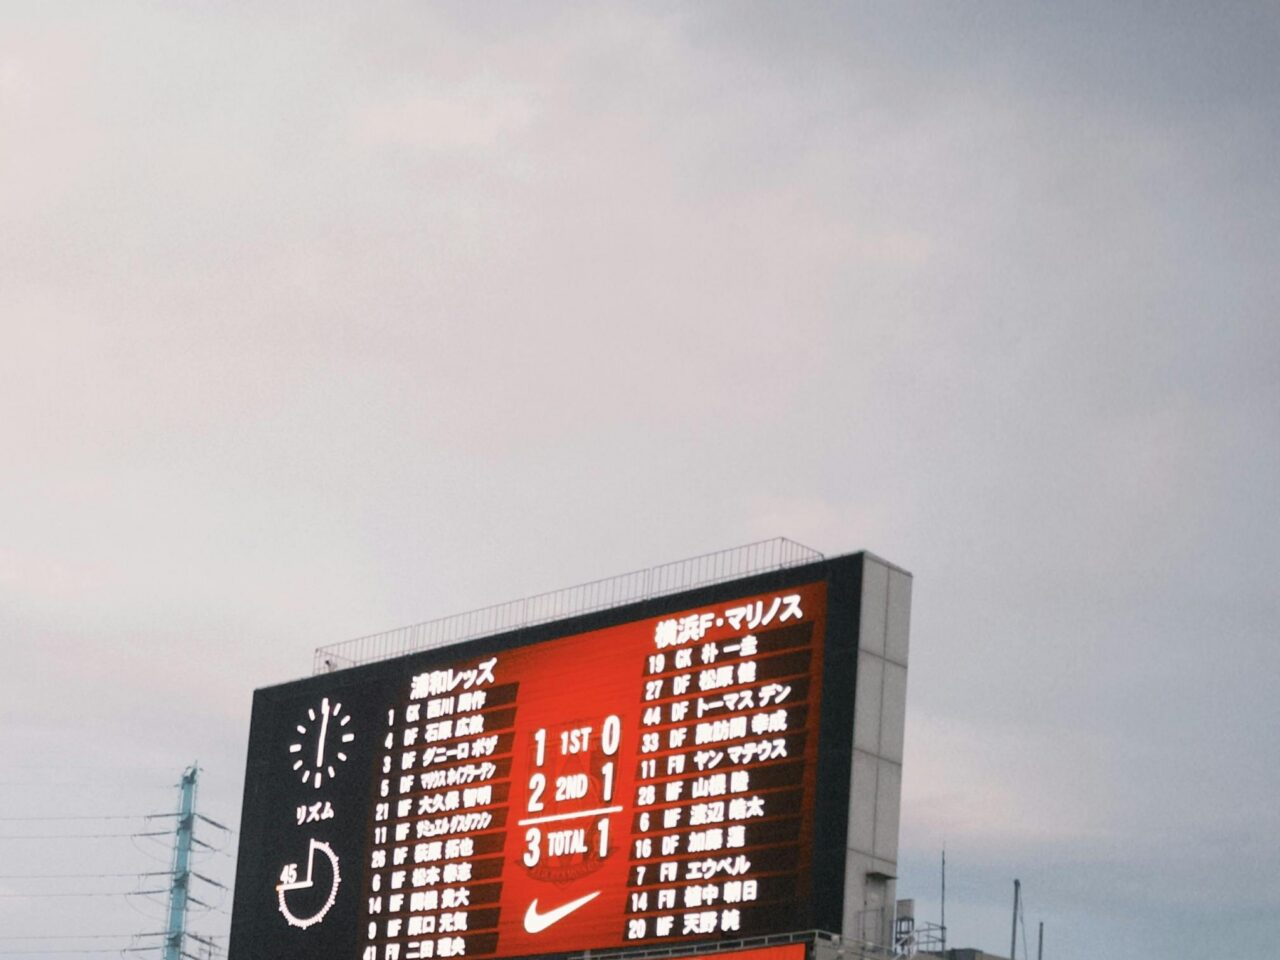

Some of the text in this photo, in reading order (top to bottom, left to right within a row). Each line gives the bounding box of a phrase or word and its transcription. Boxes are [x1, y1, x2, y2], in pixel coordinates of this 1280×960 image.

[649, 653, 665, 674] 19
[410, 657, 498, 700] 浦和レッズ
[645, 679, 664, 701] 27
[673, 674, 691, 696] DF
[643, 683, 792, 726] 44 DF トーマス デン
[388, 709, 395, 726] 1
[384, 732, 394, 750] 4
[535, 715, 621, 766] 1 1ST 0
[641, 732, 659, 753] 33
[669, 727, 688, 748] DF
[382, 755, 392, 774] 3
[641, 759, 656, 779] 11
[693, 750, 724, 771] ヤン
[727, 738, 787, 764] マテウス
[380, 779, 390, 797] 5
[527, 762, 614, 812] 2 2ND 1
[637, 785, 656, 806] 28
[296, 801, 334, 825] リズム
[375, 802, 389, 821] 21
[639, 812, 650, 832] 6
[374, 826, 387, 845] 11
[523, 818, 609, 867] 3 TOTAL 1
[635, 838, 652, 859] 16
[661, 834, 680, 856] DF
[280, 863, 298, 884] 45
[372, 873, 381, 892] 6
[636, 866, 646, 886] 7
[368, 896, 382, 915] 14
[631, 892, 648, 912] 14
[368, 921, 377, 940] 9
[628, 918, 646, 939] 20
